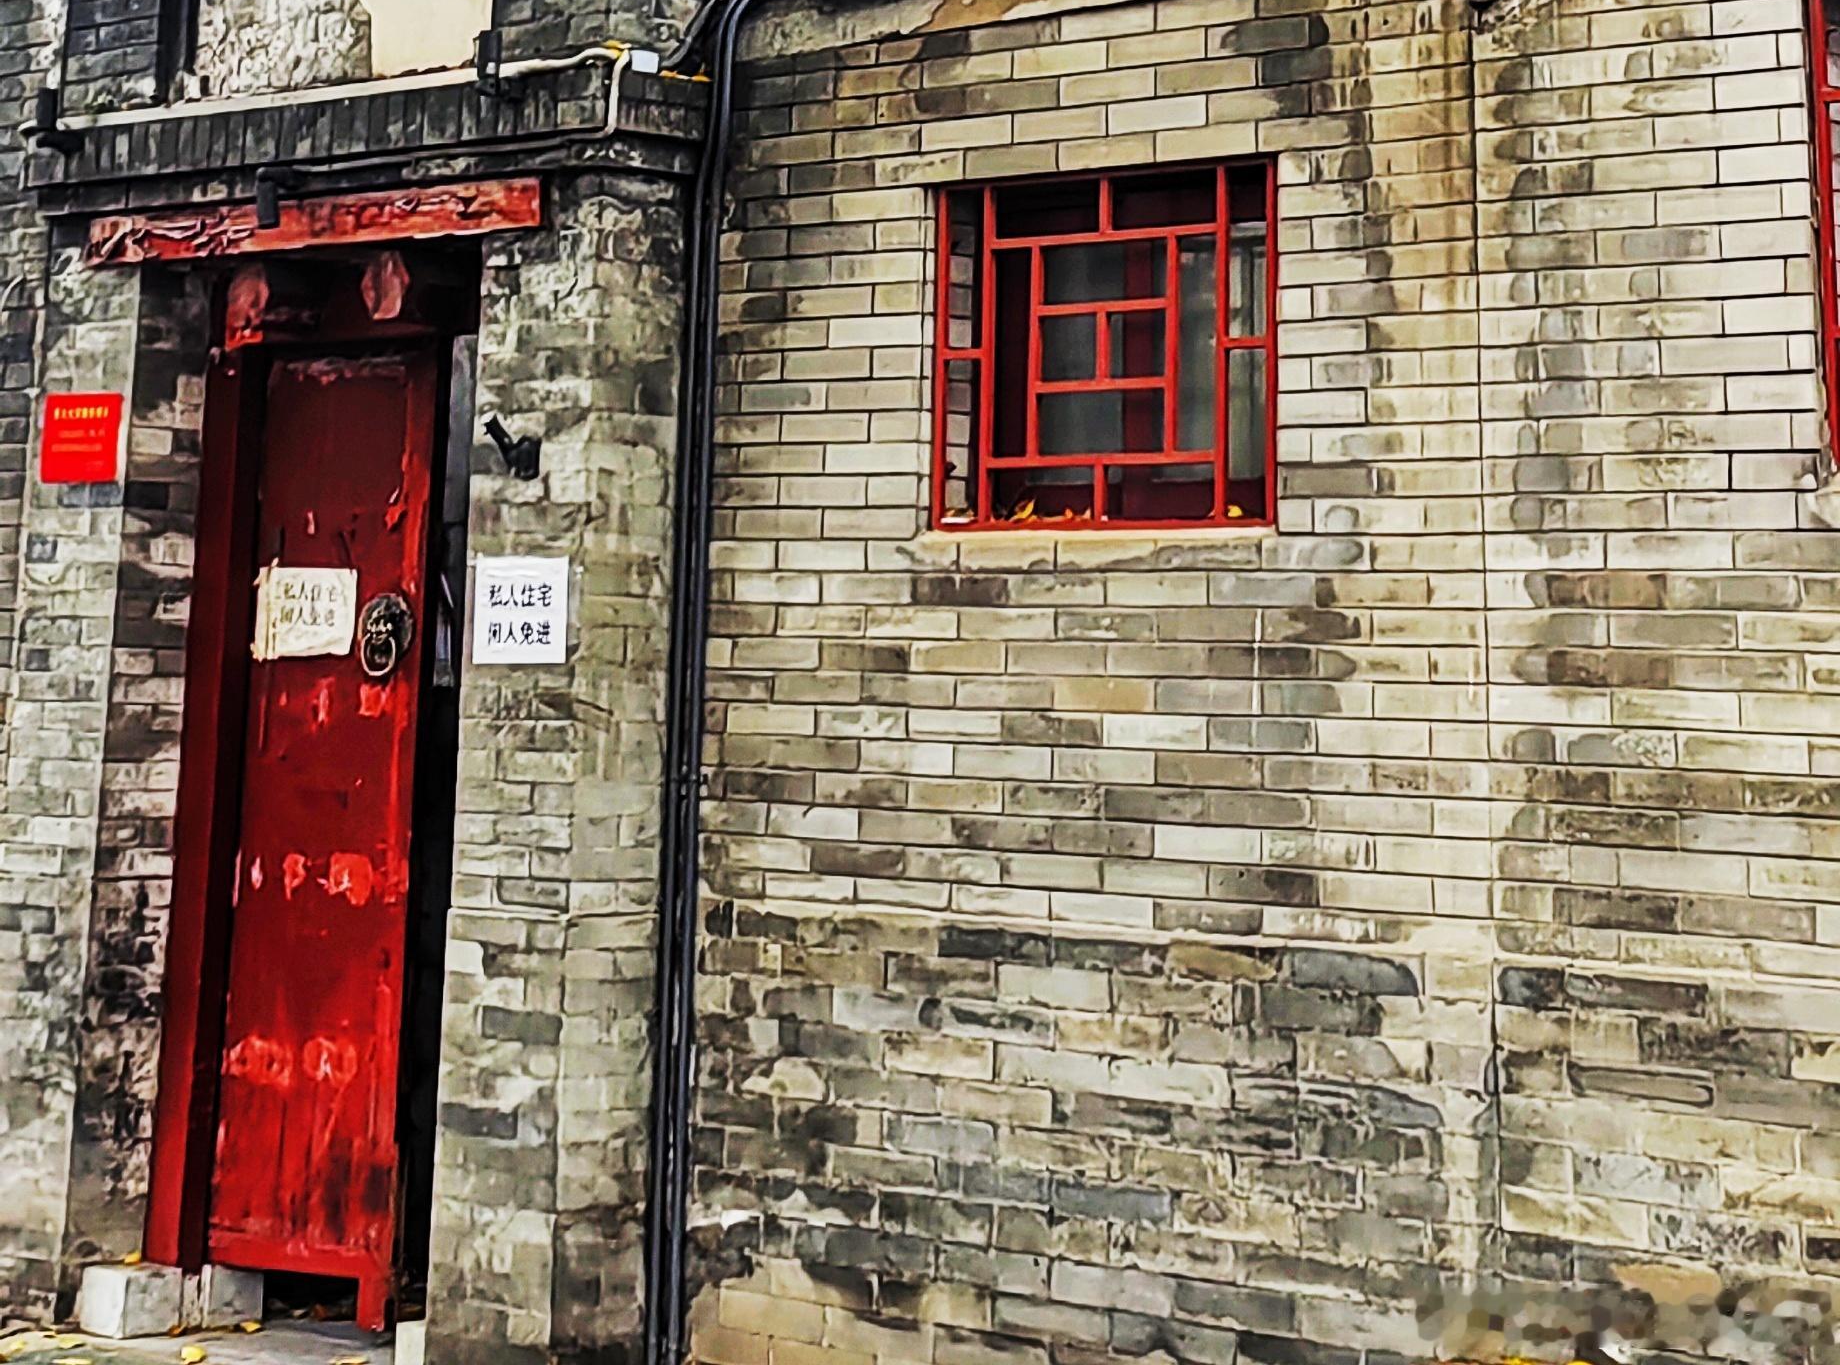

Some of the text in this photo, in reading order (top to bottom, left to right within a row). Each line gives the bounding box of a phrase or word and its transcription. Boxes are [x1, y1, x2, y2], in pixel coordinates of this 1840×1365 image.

[489, 582, 552, 607] 私人住宅
[488, 620, 551, 645] 闲人免进
